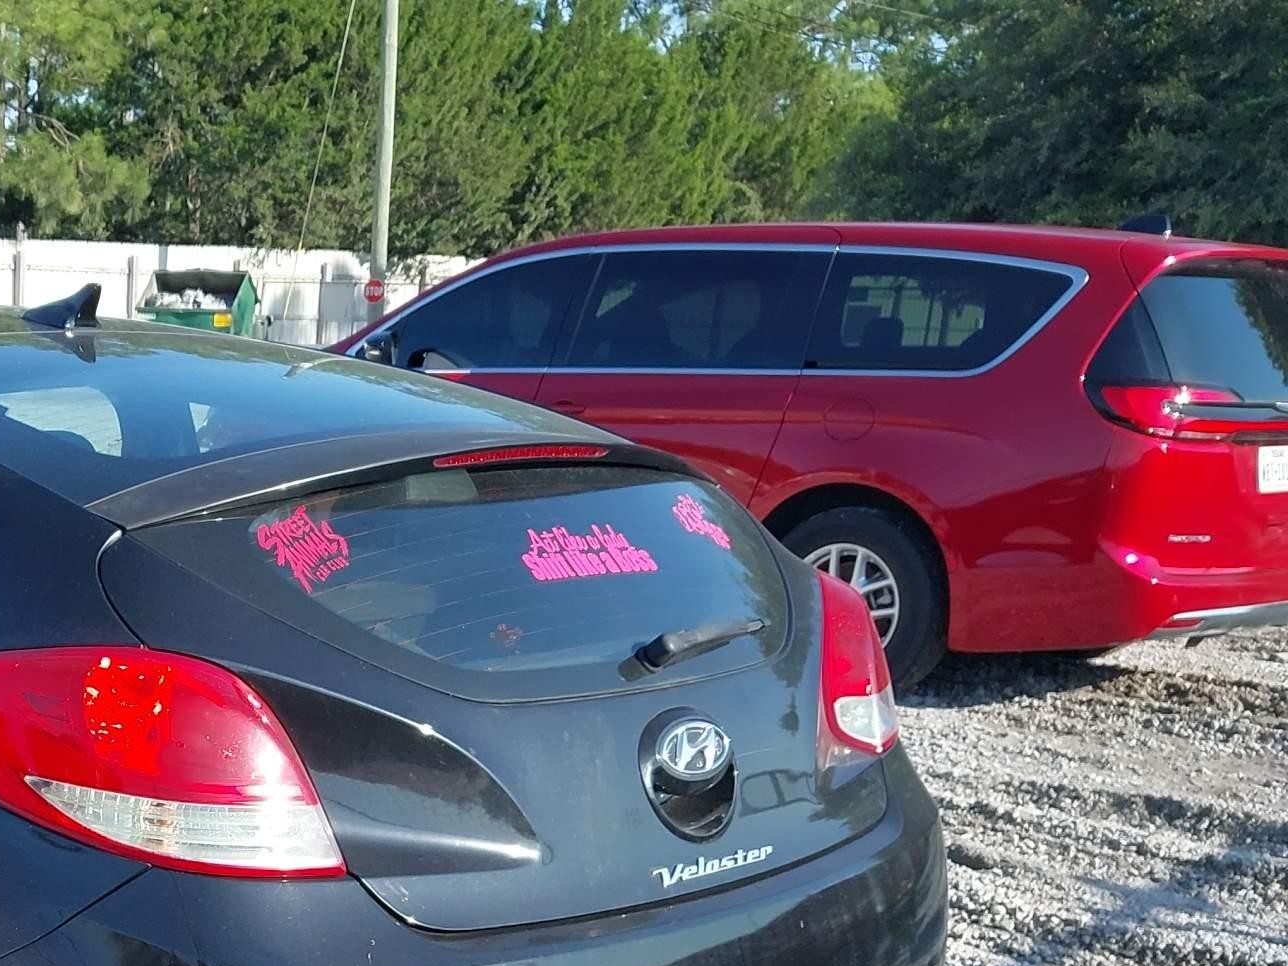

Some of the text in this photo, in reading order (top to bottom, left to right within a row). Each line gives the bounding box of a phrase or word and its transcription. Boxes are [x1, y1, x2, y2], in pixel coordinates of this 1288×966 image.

[365, 286, 383, 296] STOP
[257, 504, 318, 567] STREET
[651, 845, 773, 888] Veloster
